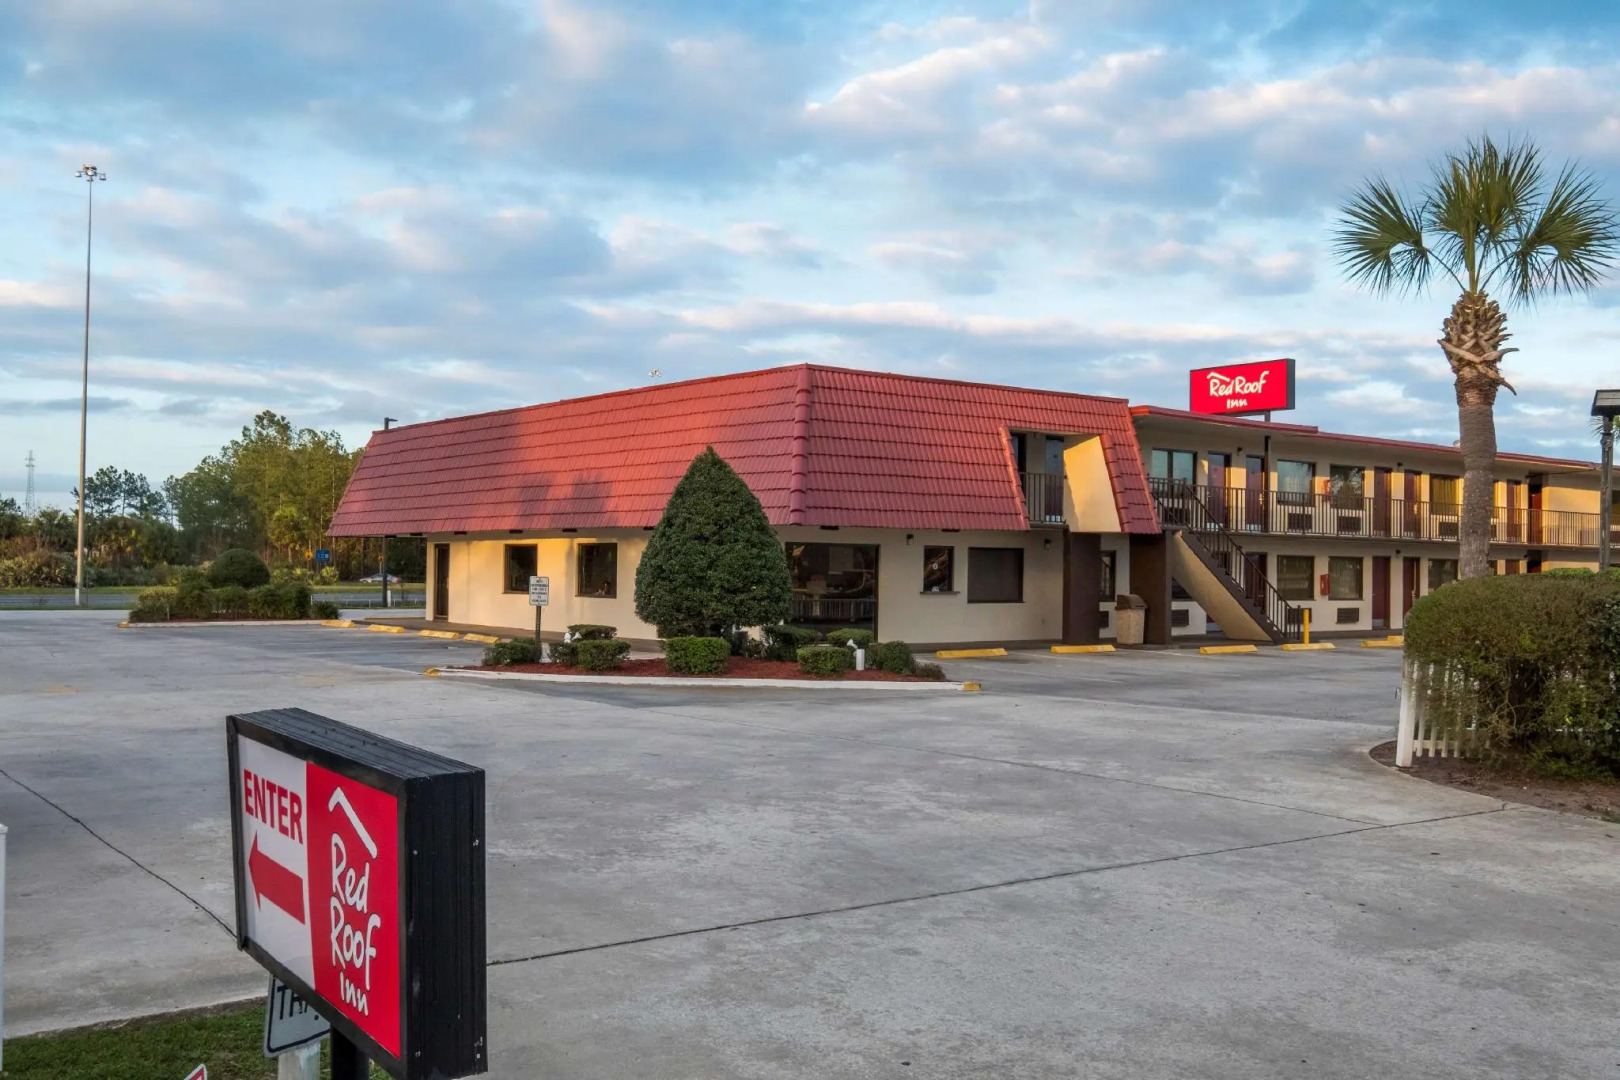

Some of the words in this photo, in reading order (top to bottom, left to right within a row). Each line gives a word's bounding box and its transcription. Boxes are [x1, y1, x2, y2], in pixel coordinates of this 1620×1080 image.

[1210, 378, 1234, 397] Red
[1235, 371, 1269, 394] Roof
[244, 770, 303, 845] ENTER
[331, 832, 370, 913] Red
[330, 895, 381, 989] Roof
